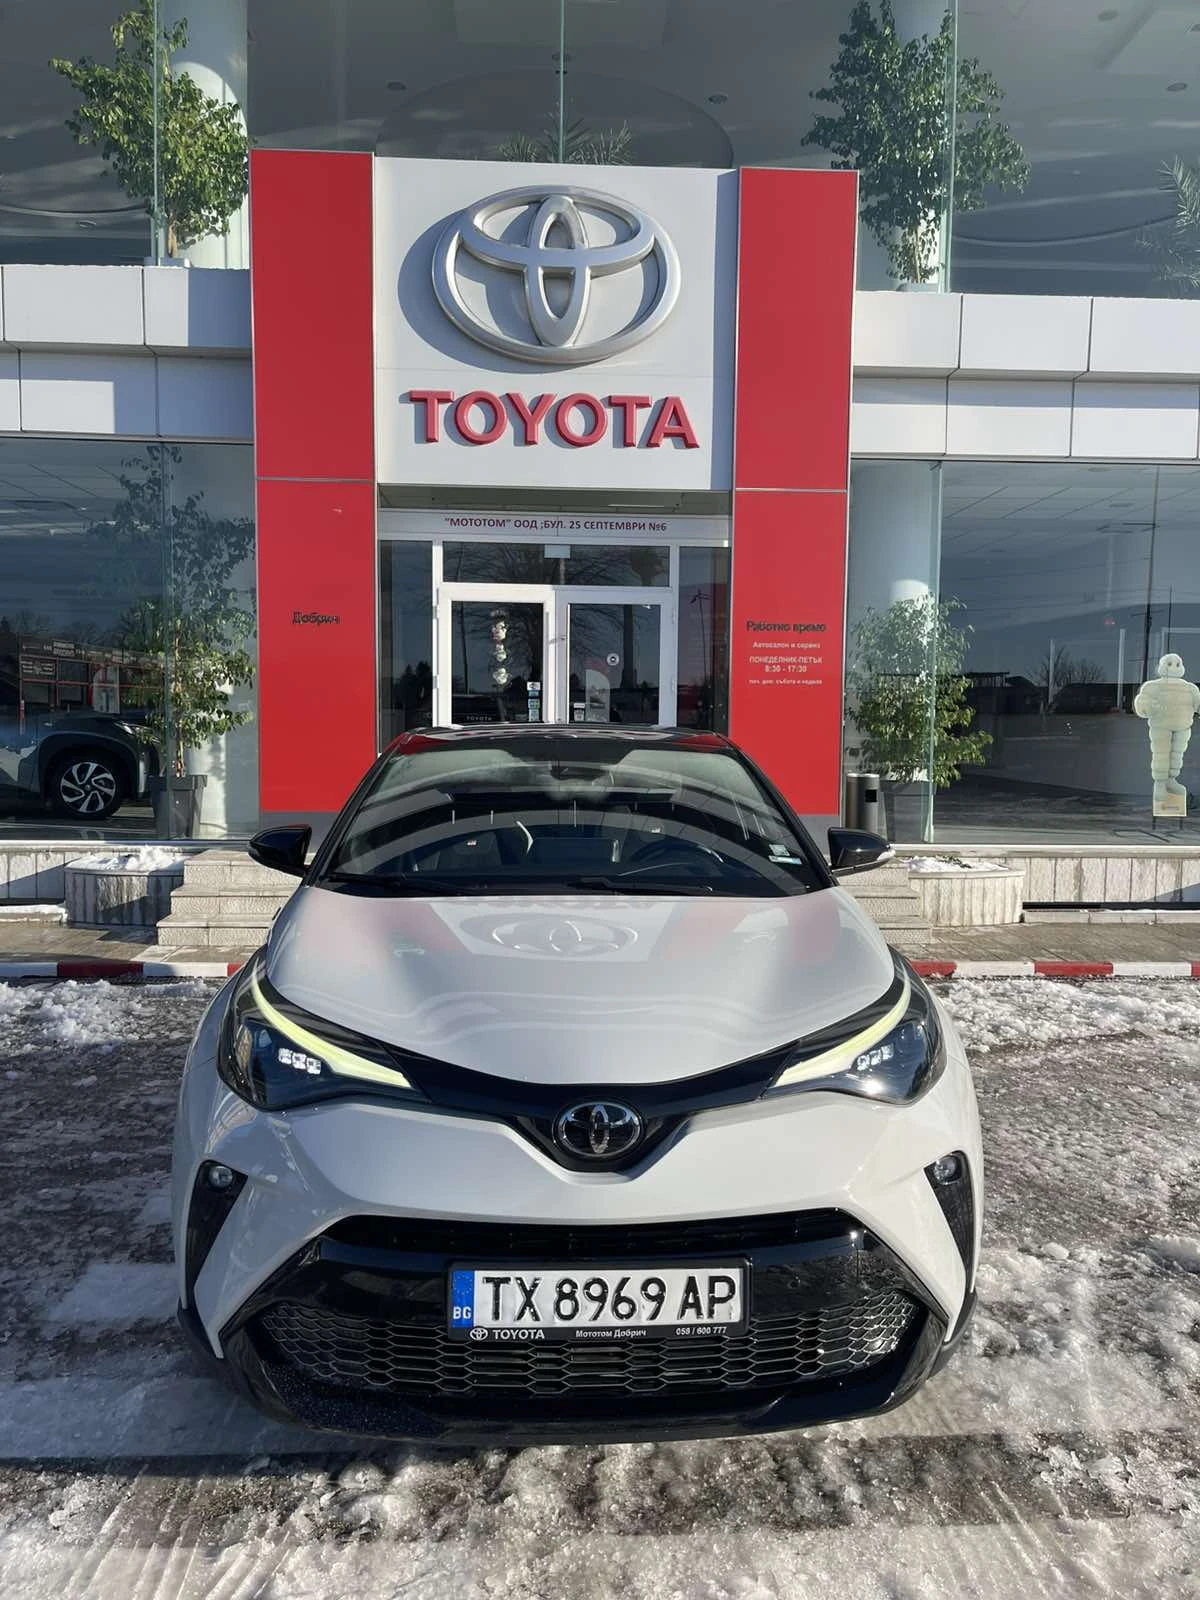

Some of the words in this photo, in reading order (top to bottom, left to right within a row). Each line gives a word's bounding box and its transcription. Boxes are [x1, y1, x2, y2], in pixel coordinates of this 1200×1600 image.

[409, 390, 700, 448] TOYOTA
[514, 520, 538, 530] ООД
[569, 521, 581, 529] 25
[583, 521, 646, 531] СЕПТЕМВРИ
[648, 522, 667, 531] №6
[788, 665, 807, 673] 17:30
[483, 1276, 541, 1321] TX
[554, 1276, 667, 1321] 8969
[677, 1275, 736, 1320] AP
[453, 1306, 472, 1319] BG
[493, 1329, 545, 1340] TOYOTA
[575, 1329, 613, 1338] Мототом
[614, 1329, 647, 1339] Добрич
[676, 1327, 691, 1335] 058
[697, 1327, 711, 1335] 600
[712, 1326, 727, 1334] 777
